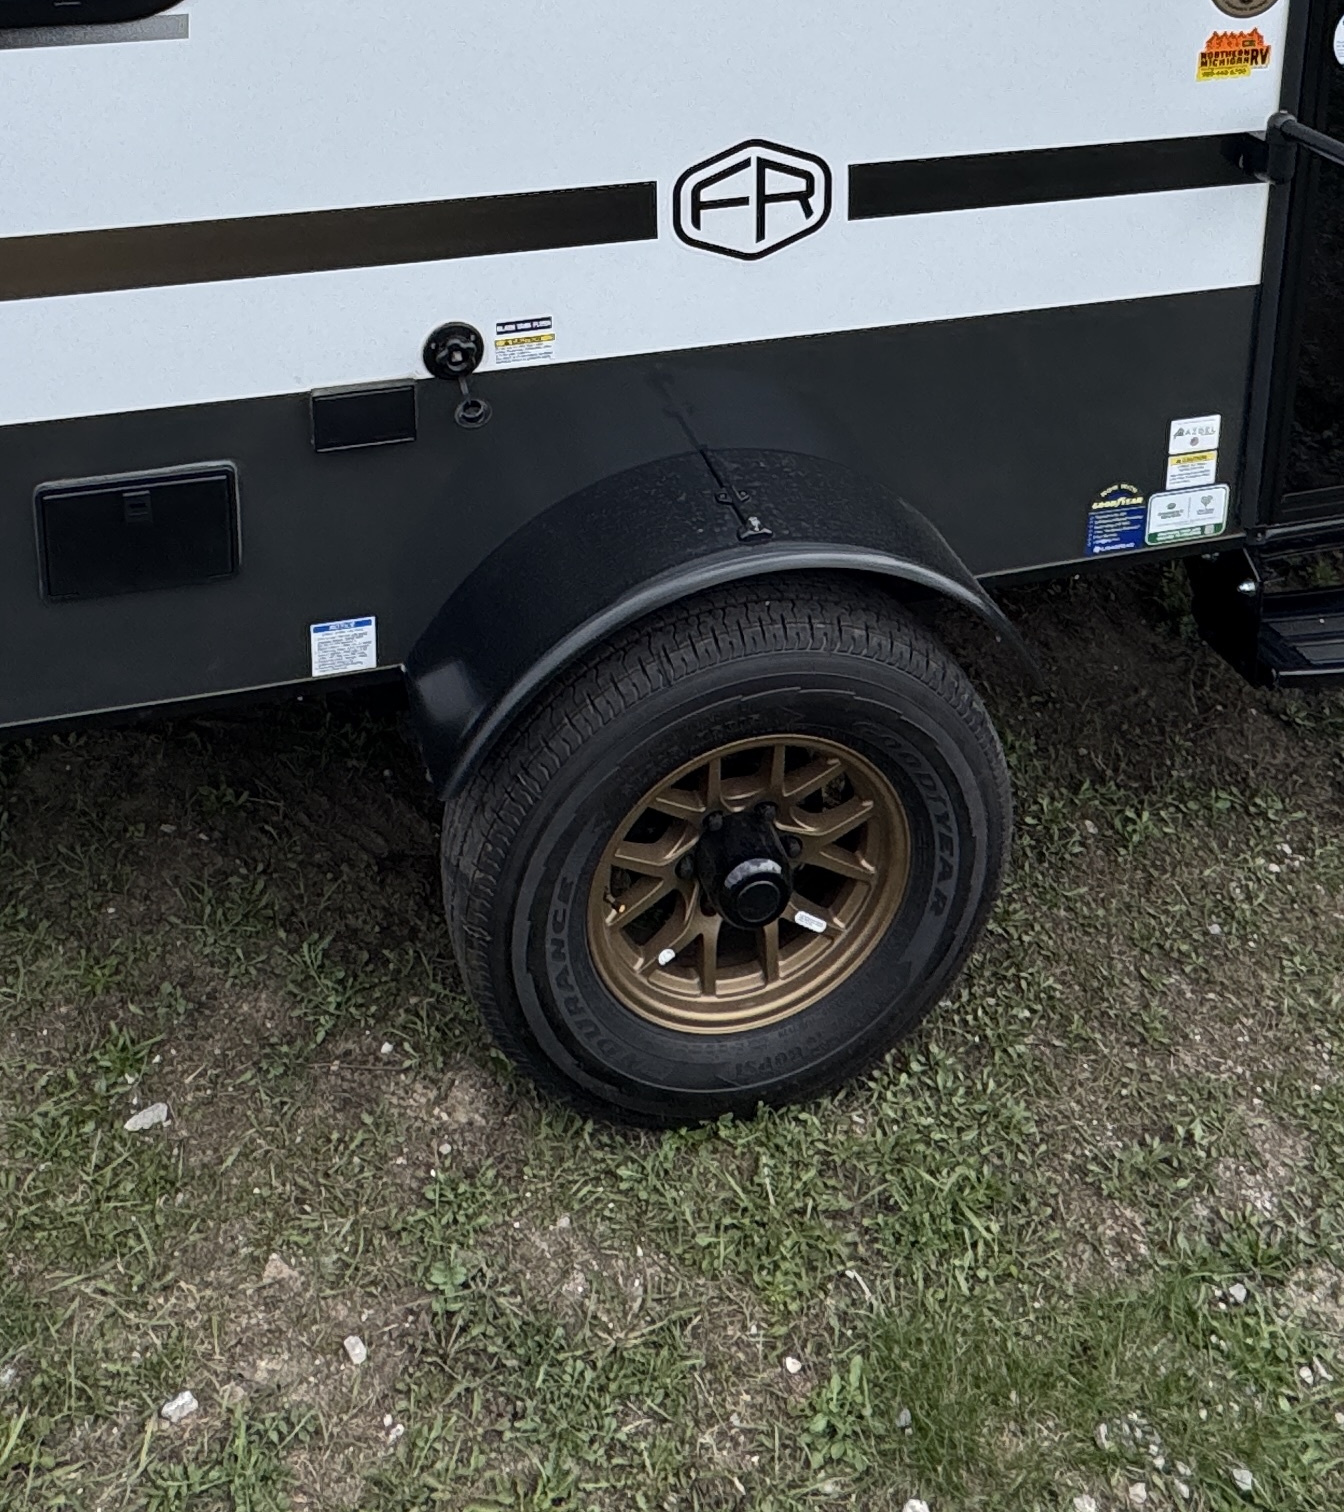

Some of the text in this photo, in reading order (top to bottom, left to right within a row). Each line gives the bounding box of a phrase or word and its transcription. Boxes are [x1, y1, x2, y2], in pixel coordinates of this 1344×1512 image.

[1200, 45, 1272, 66] NORTHERN RV
[1200, 57, 1250, 68] MICHIGAN
[689, 154, 815, 244] FR
[853, 720, 956, 916] GOODYEAR
